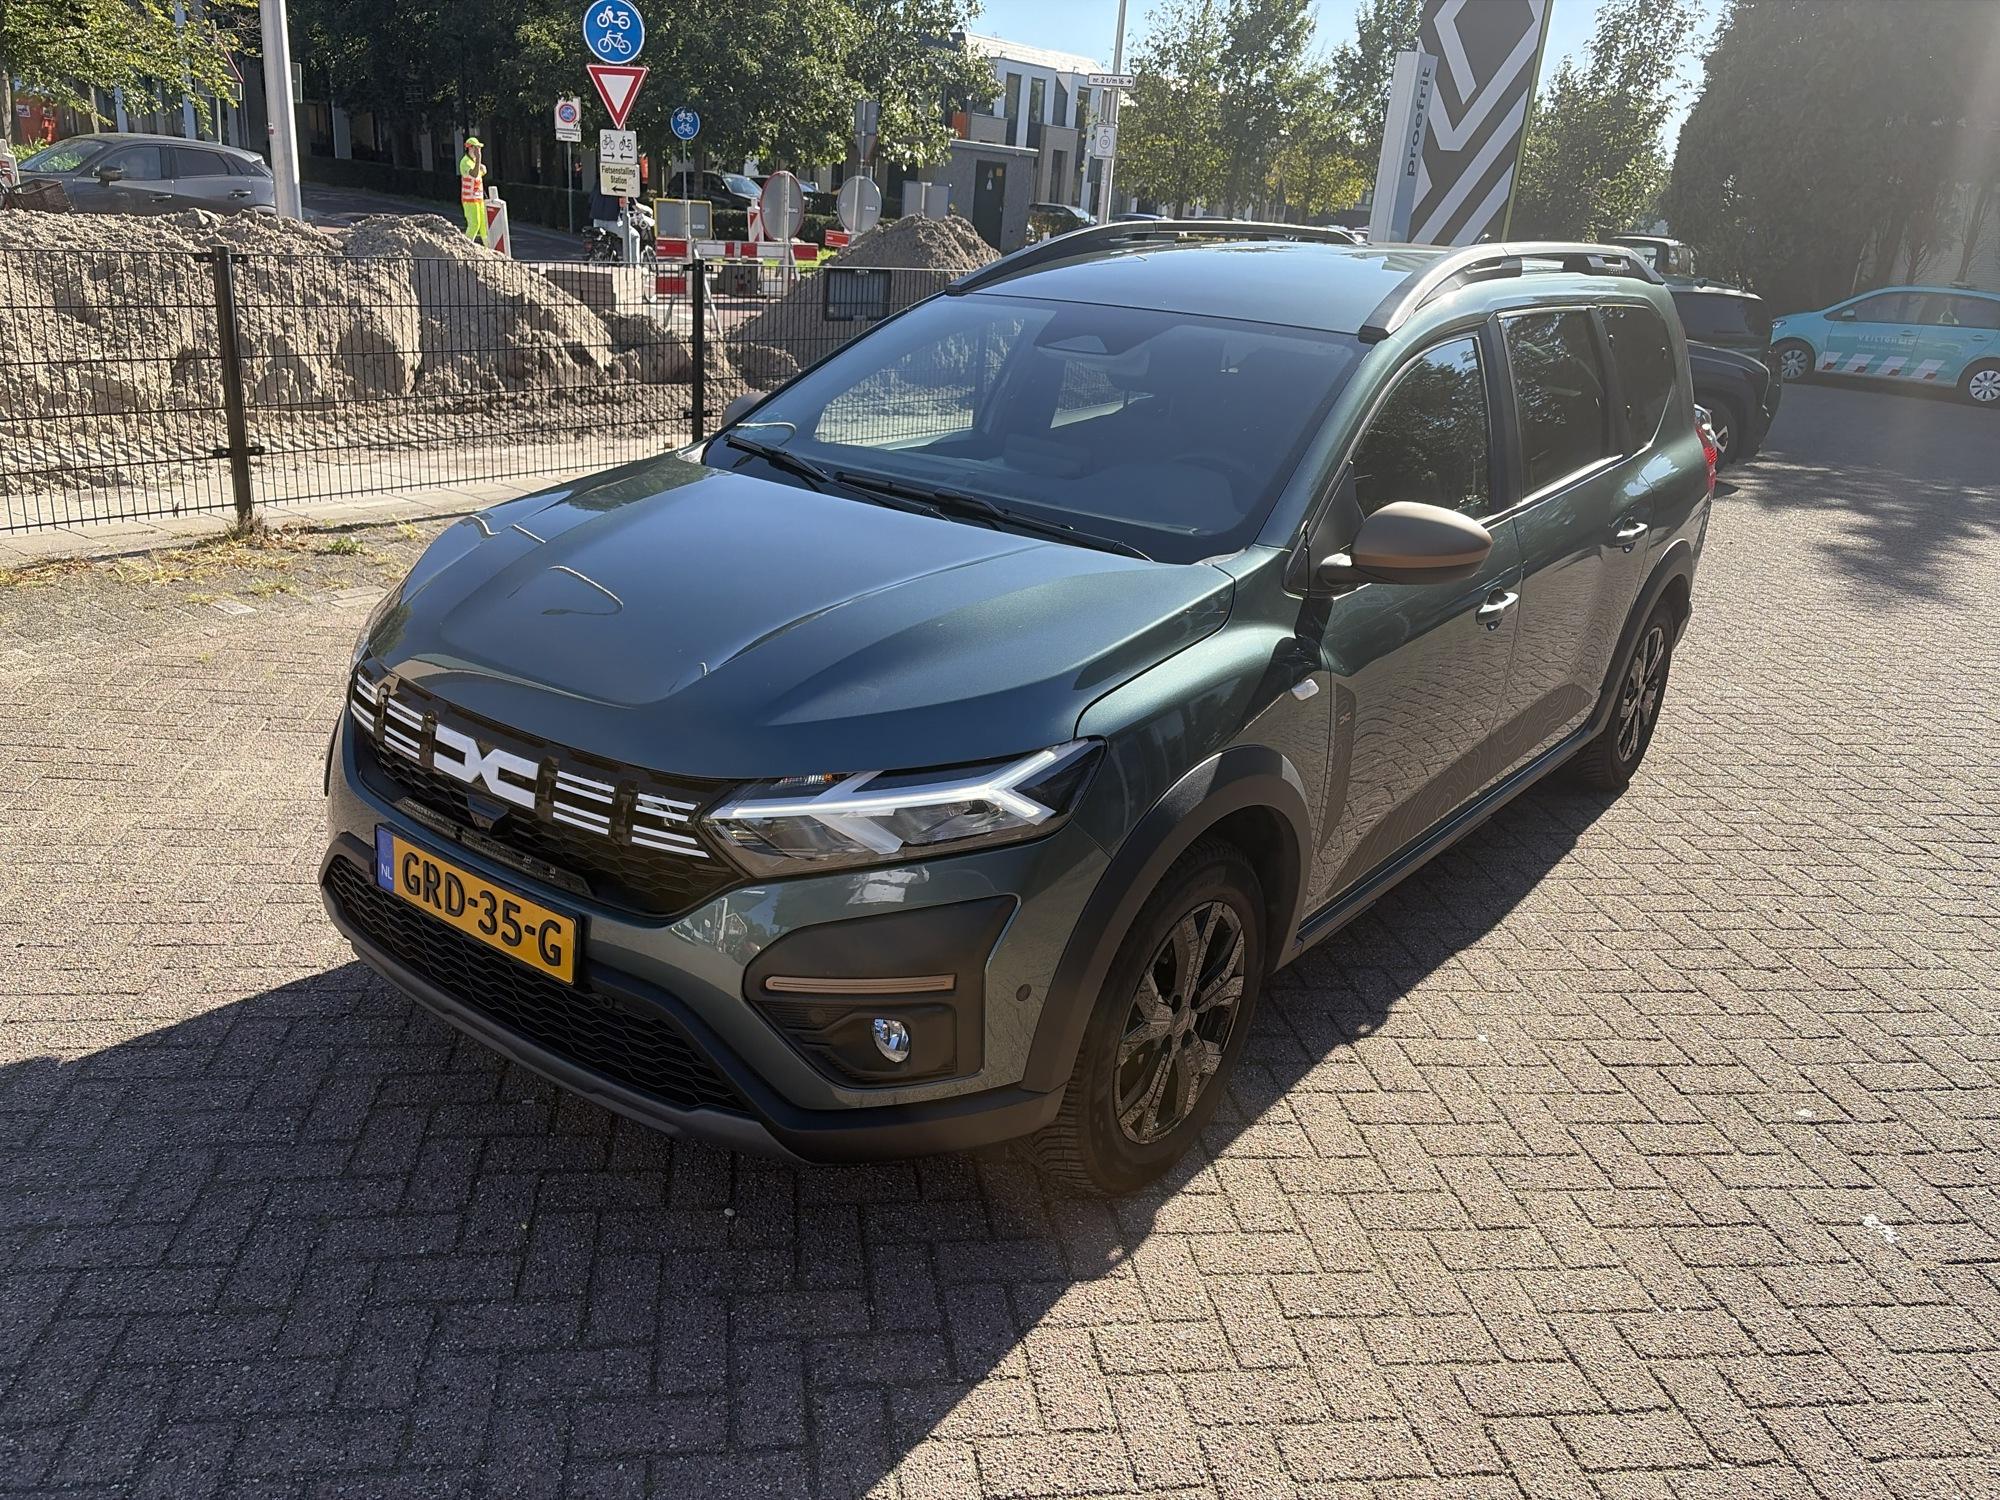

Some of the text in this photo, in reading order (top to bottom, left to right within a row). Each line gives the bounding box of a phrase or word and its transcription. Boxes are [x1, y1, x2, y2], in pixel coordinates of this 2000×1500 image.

[1407, 67, 1431, 176] proefrit
[611, 175, 628, 184] Station
[381, 864, 393, 881] NL
[402, 851, 562, 967] GRD-35-G
